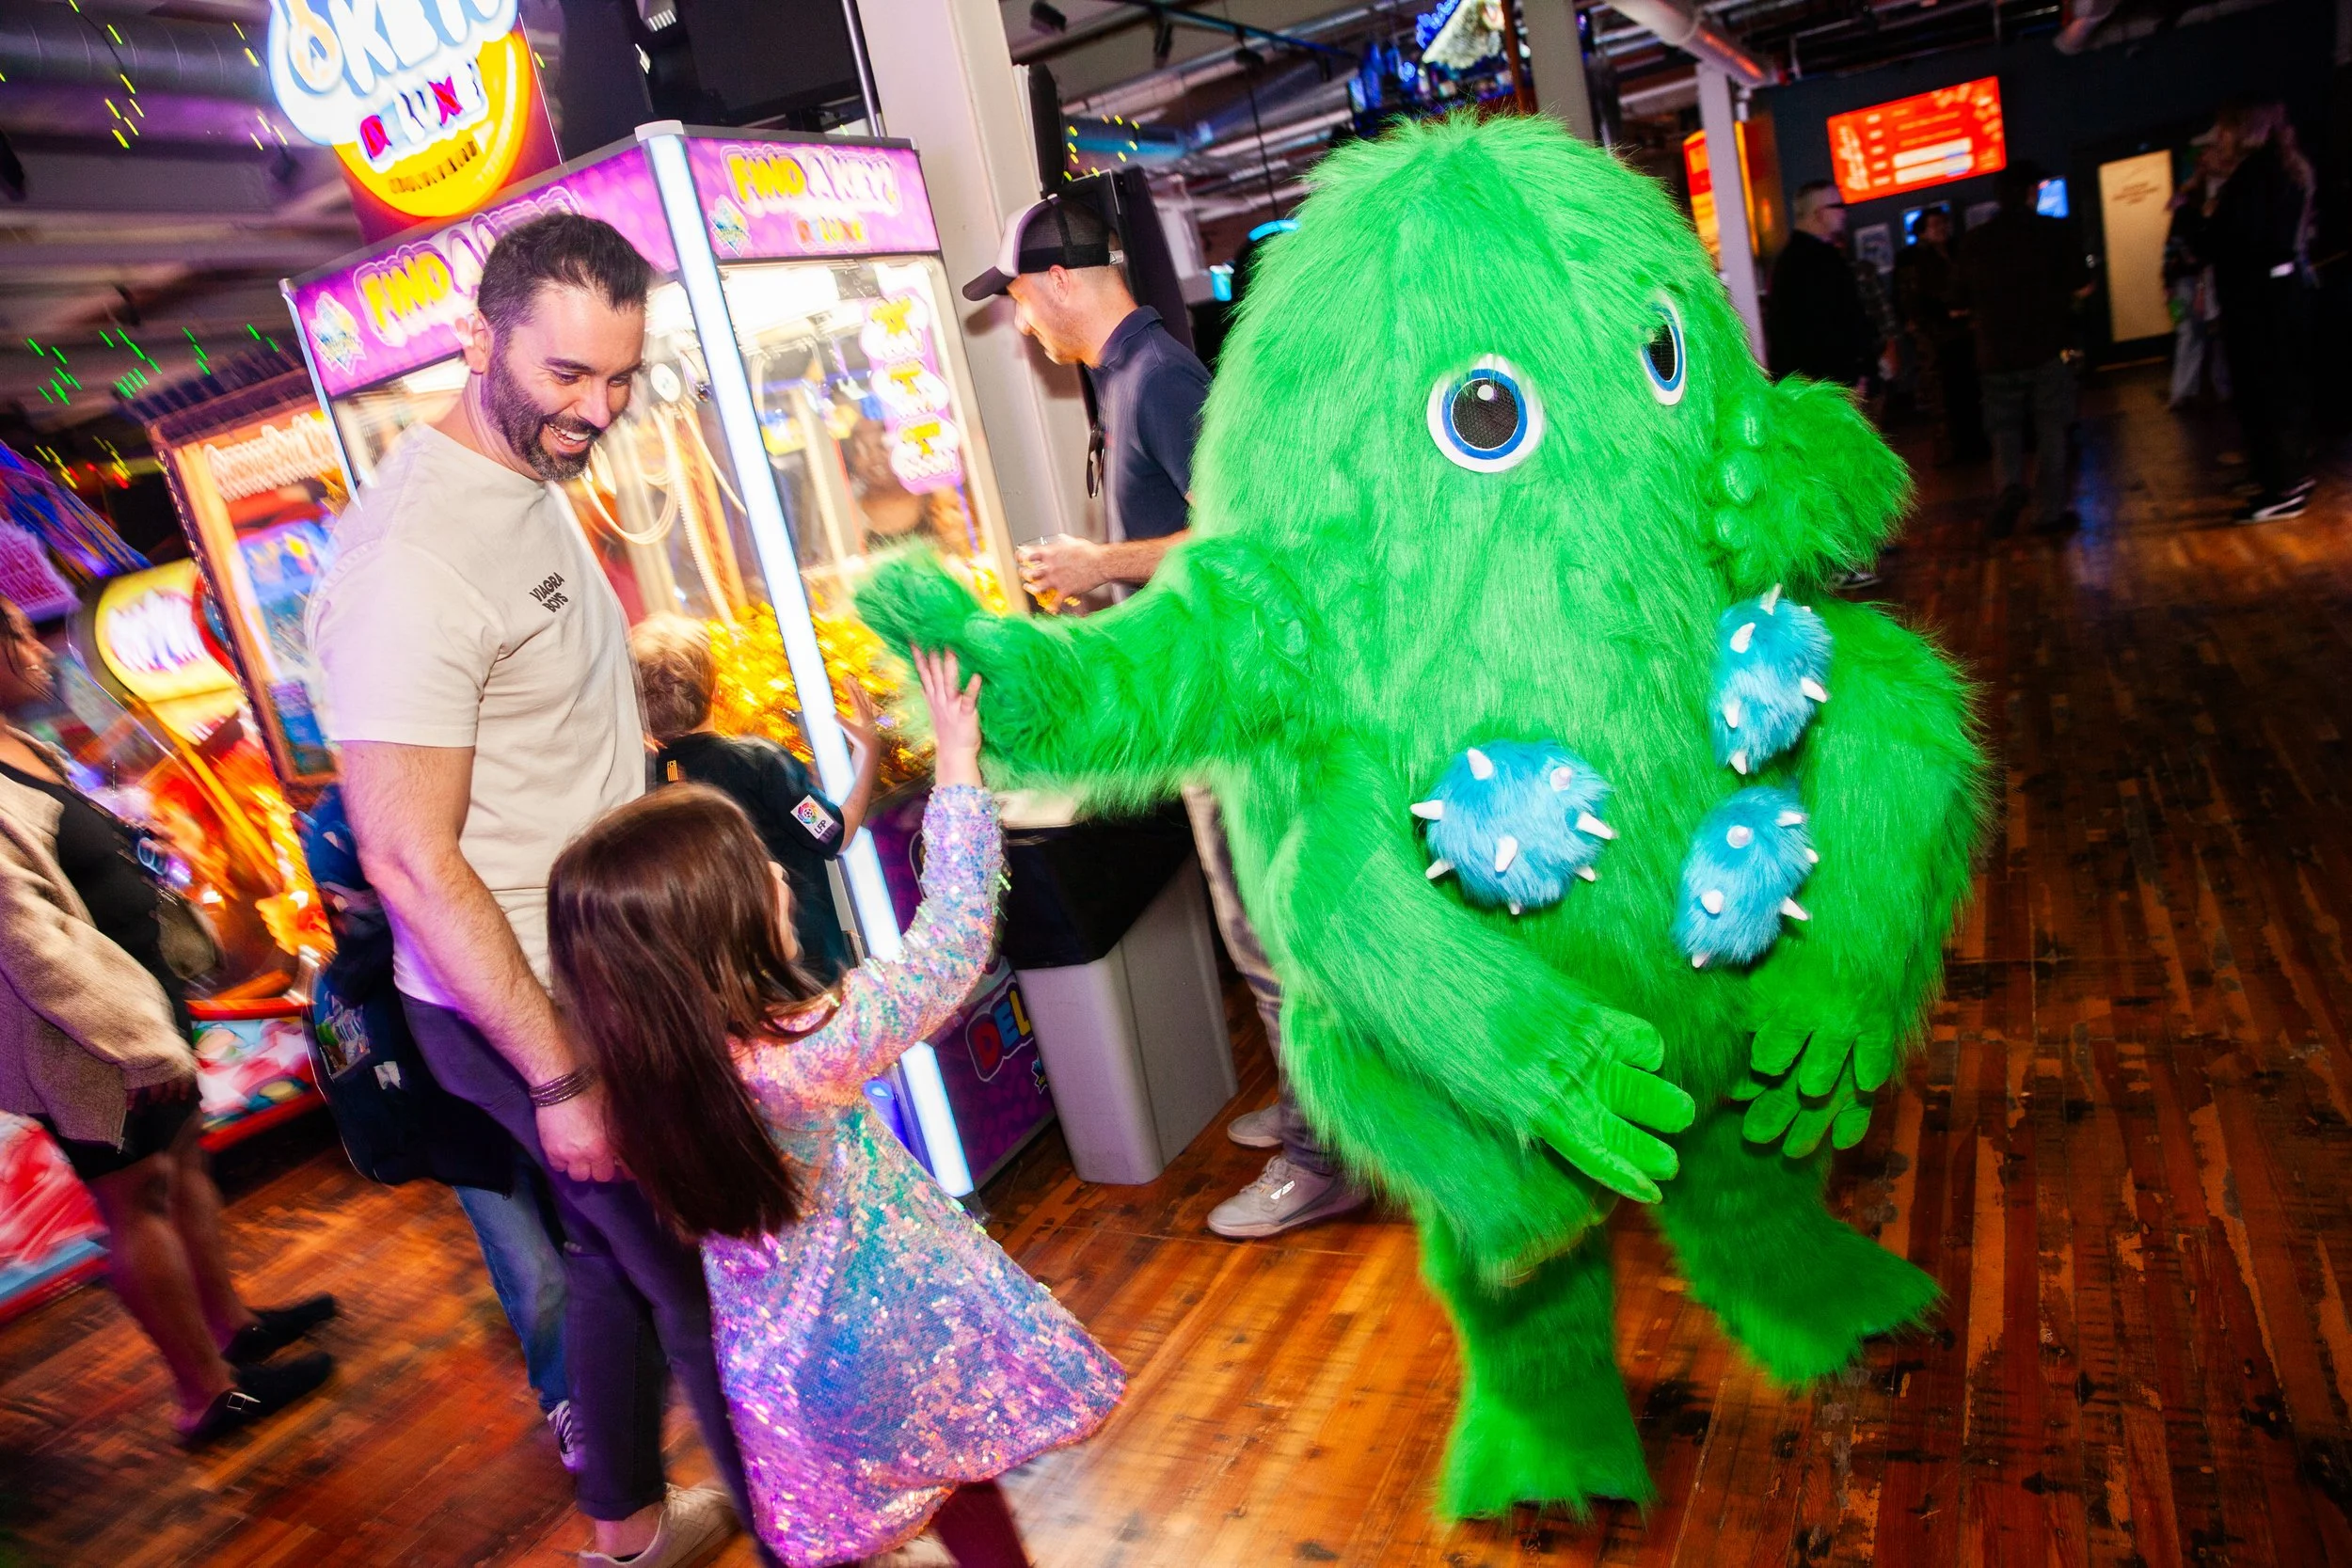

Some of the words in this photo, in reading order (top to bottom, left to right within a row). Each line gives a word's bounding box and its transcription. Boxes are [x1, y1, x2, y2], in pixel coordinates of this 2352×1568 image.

[725, 150, 807, 204] FIND
[361, 249, 450, 331] FIND
[529, 572, 565, 602] VIAGRA
[542, 592, 569, 613] BOYS
[814, 819, 827, 834] LFP
